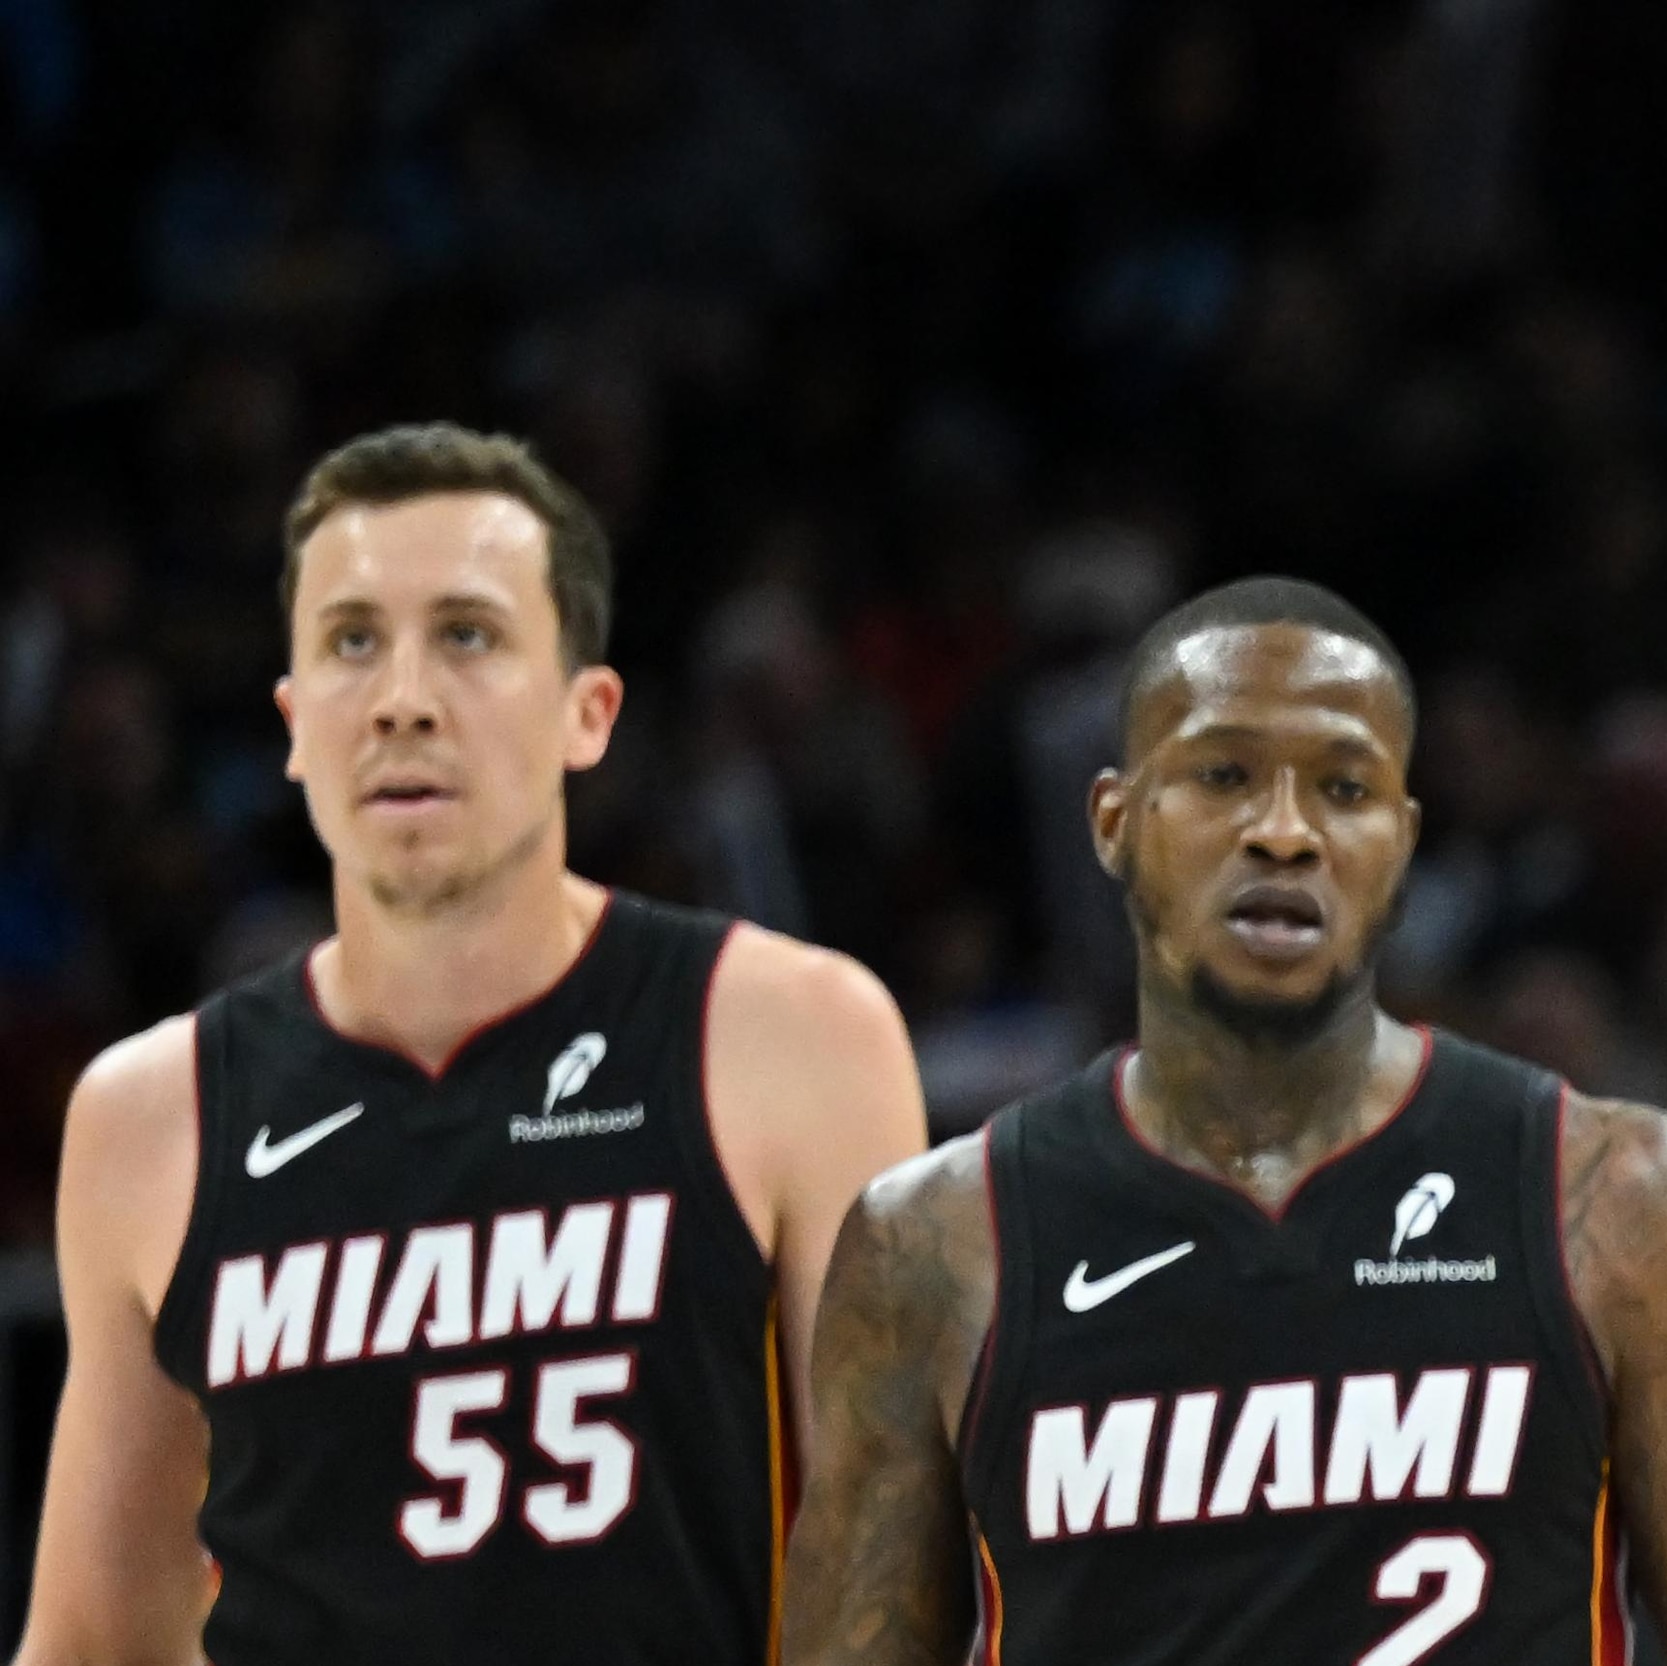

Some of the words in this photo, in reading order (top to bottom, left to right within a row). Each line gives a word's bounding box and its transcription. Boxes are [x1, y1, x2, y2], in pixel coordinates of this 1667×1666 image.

[202, 1189, 675, 1396] MIAMI
[1353, 1254, 1497, 1287] Robinhood
[396, 1349, 640, 1562] 55
[1021, 1362, 1536, 1544] MIAMI
